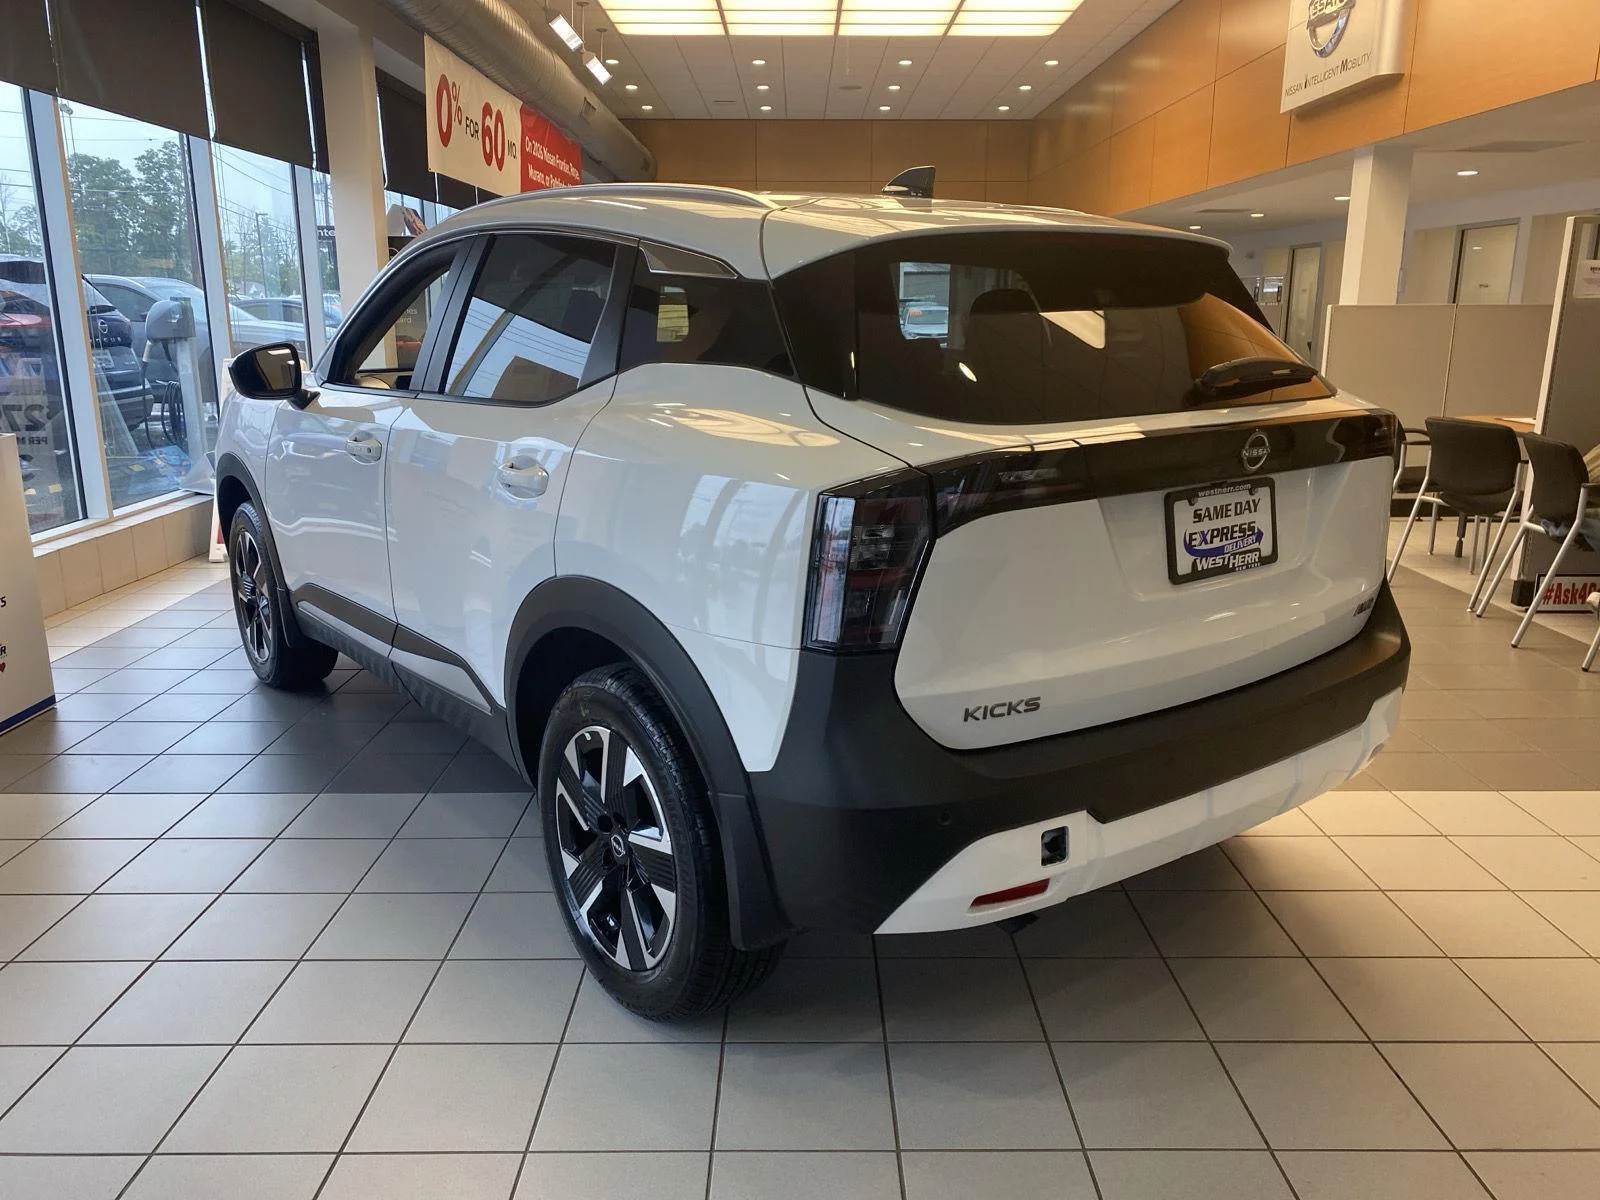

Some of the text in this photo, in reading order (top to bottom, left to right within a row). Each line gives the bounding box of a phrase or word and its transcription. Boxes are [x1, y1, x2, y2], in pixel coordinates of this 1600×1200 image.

[1284, 50, 1373, 97] NISSAN INTELLIGENT MOBILITY
[465, 116, 479, 141] FOR
[481, 101, 505, 172] 60
[525, 136, 532, 154] On
[1241, 447, 1271, 457] NISSAN
[1198, 483, 1252, 497] westherr.com
[1193, 498, 1261, 524] SAME DAY
[1188, 521, 1256, 547] EXPRESS
[1224, 536, 1257, 553] DELIVERY
[963, 696, 1041, 722] KICKS
